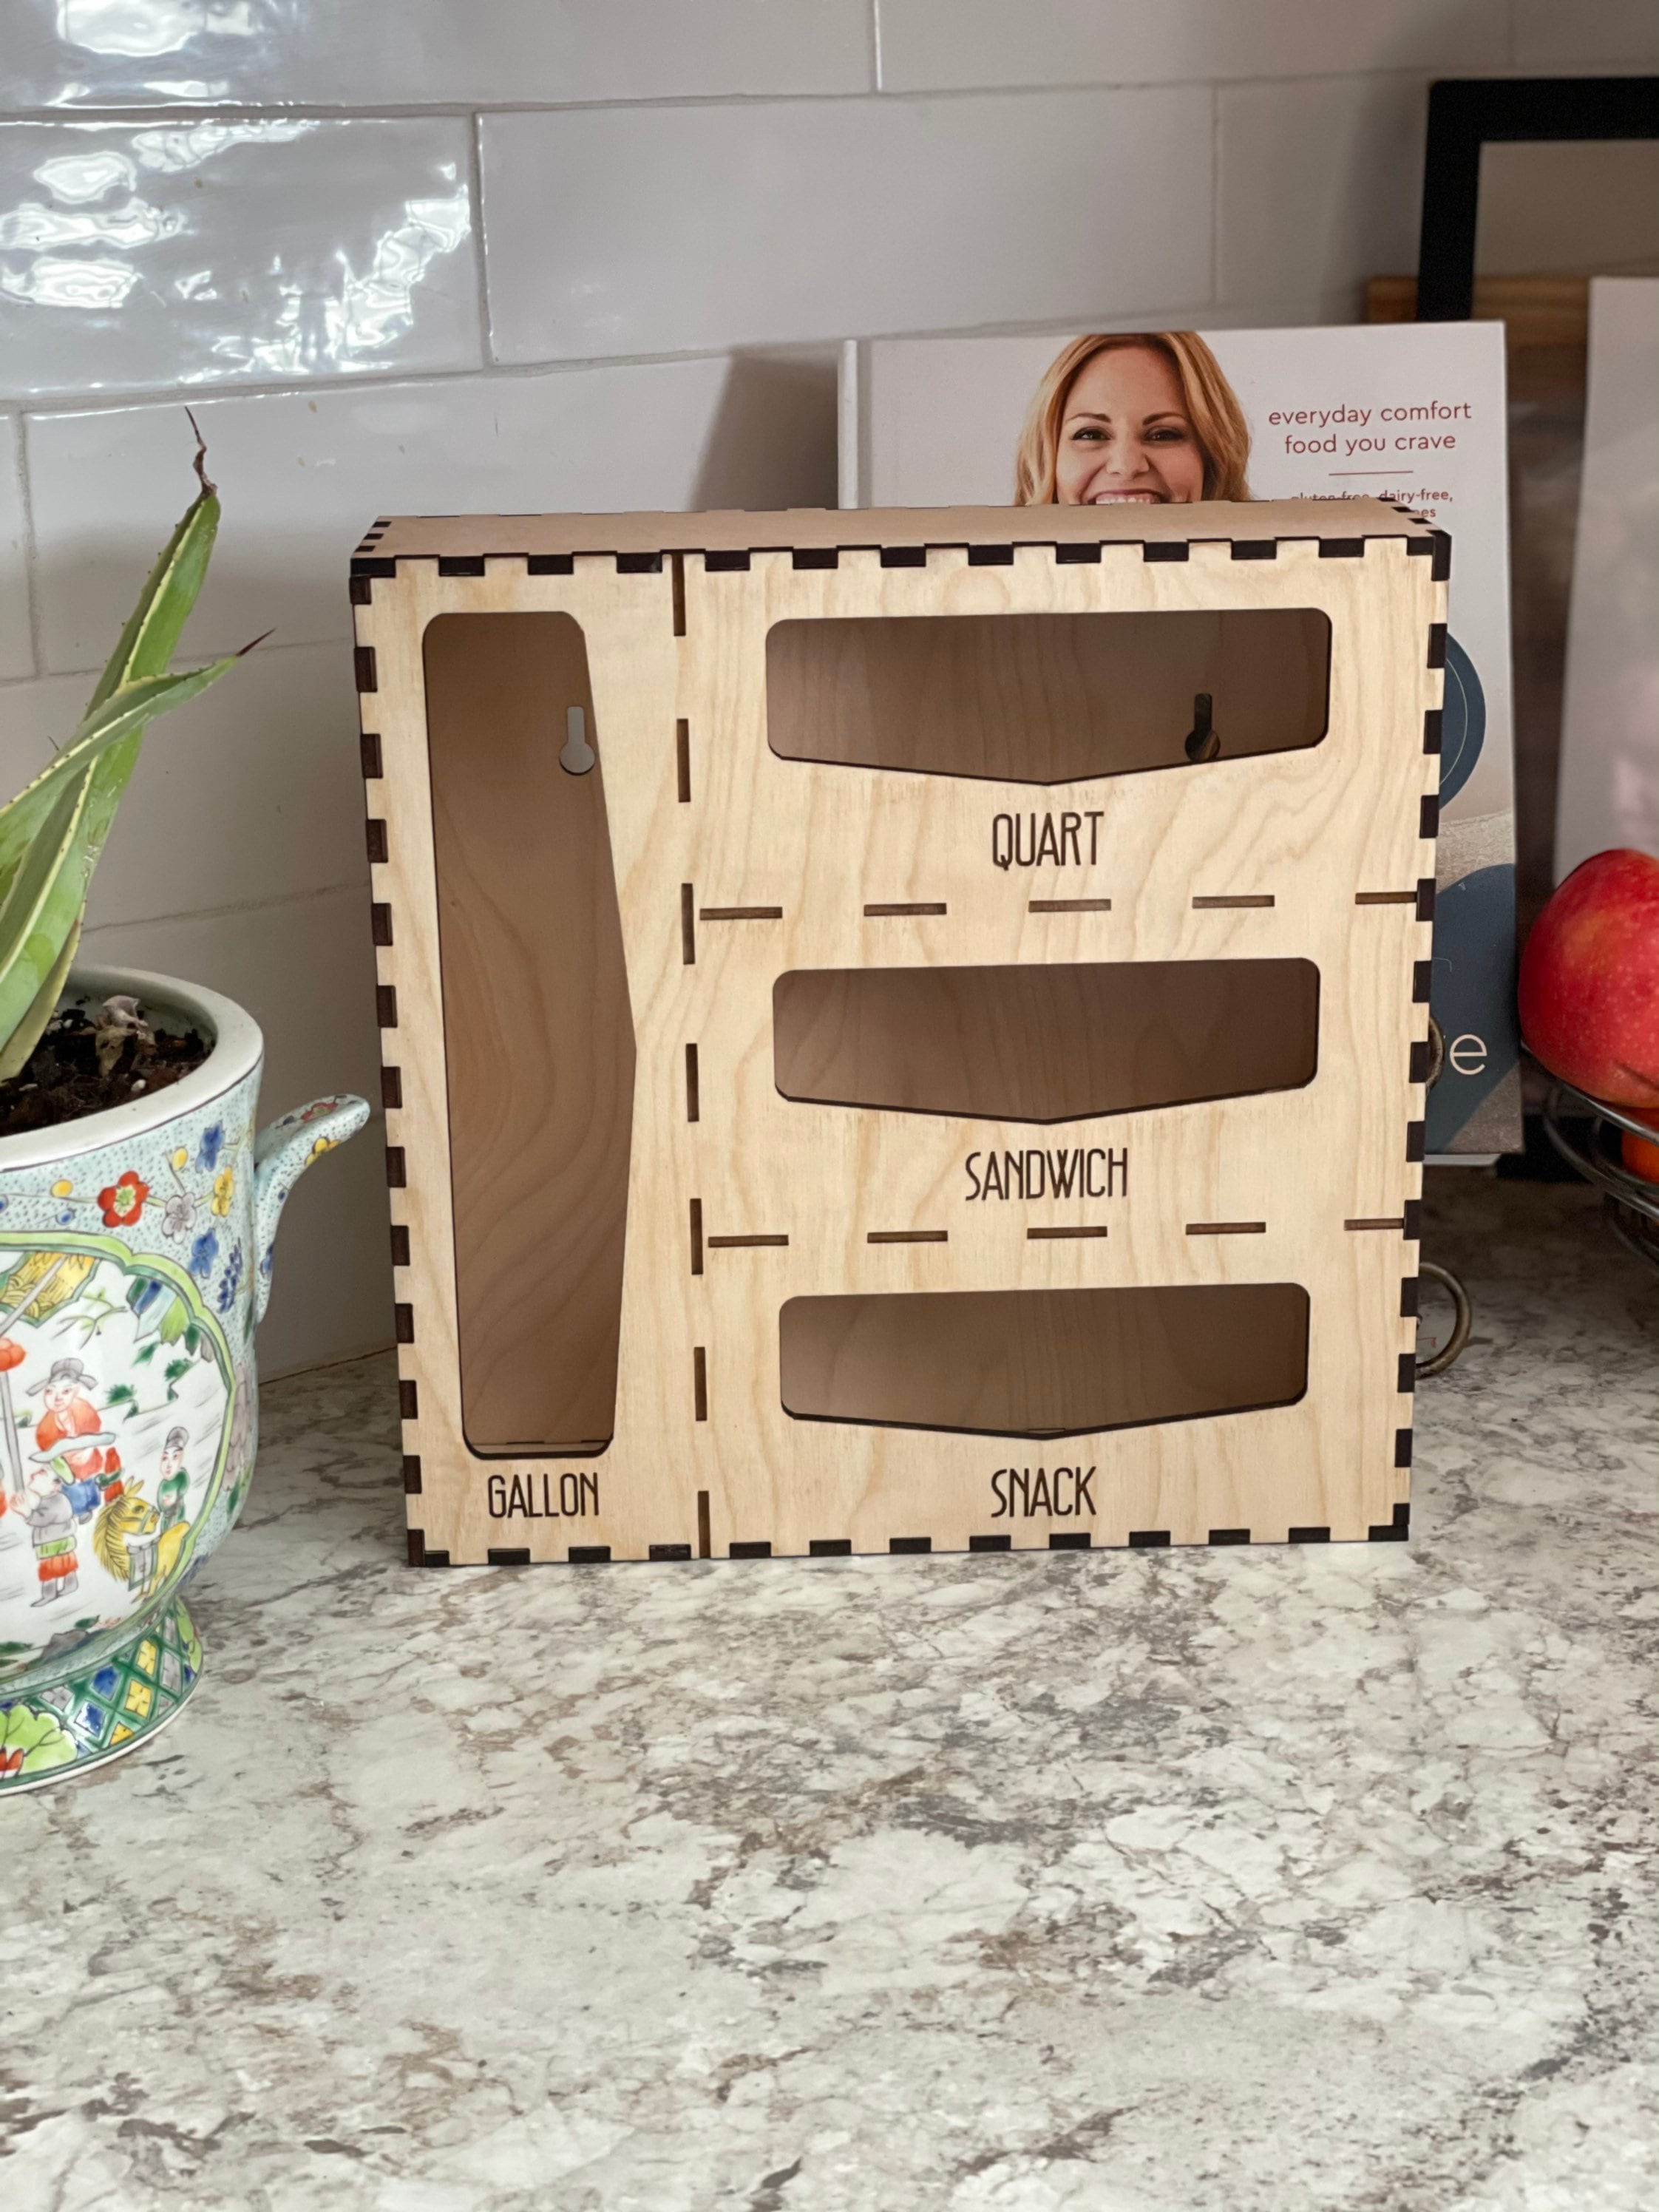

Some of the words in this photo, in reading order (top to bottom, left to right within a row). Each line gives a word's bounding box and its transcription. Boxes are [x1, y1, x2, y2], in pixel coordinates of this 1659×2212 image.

[1269, 404, 1371, 427] everyday
[1380, 401, 1471, 421] comfort
[1285, 434, 1337, 453] food
[1346, 436, 1386, 456] you
[1395, 435, 1456, 450] crave
[992, 811, 1105, 871] QUART
[1443, 1034, 1487, 1076] e
[965, 1147, 1127, 1201] SANDWICH
[487, 1472, 600, 1518] GALLON
[991, 1466, 1096, 1518] SNACK
